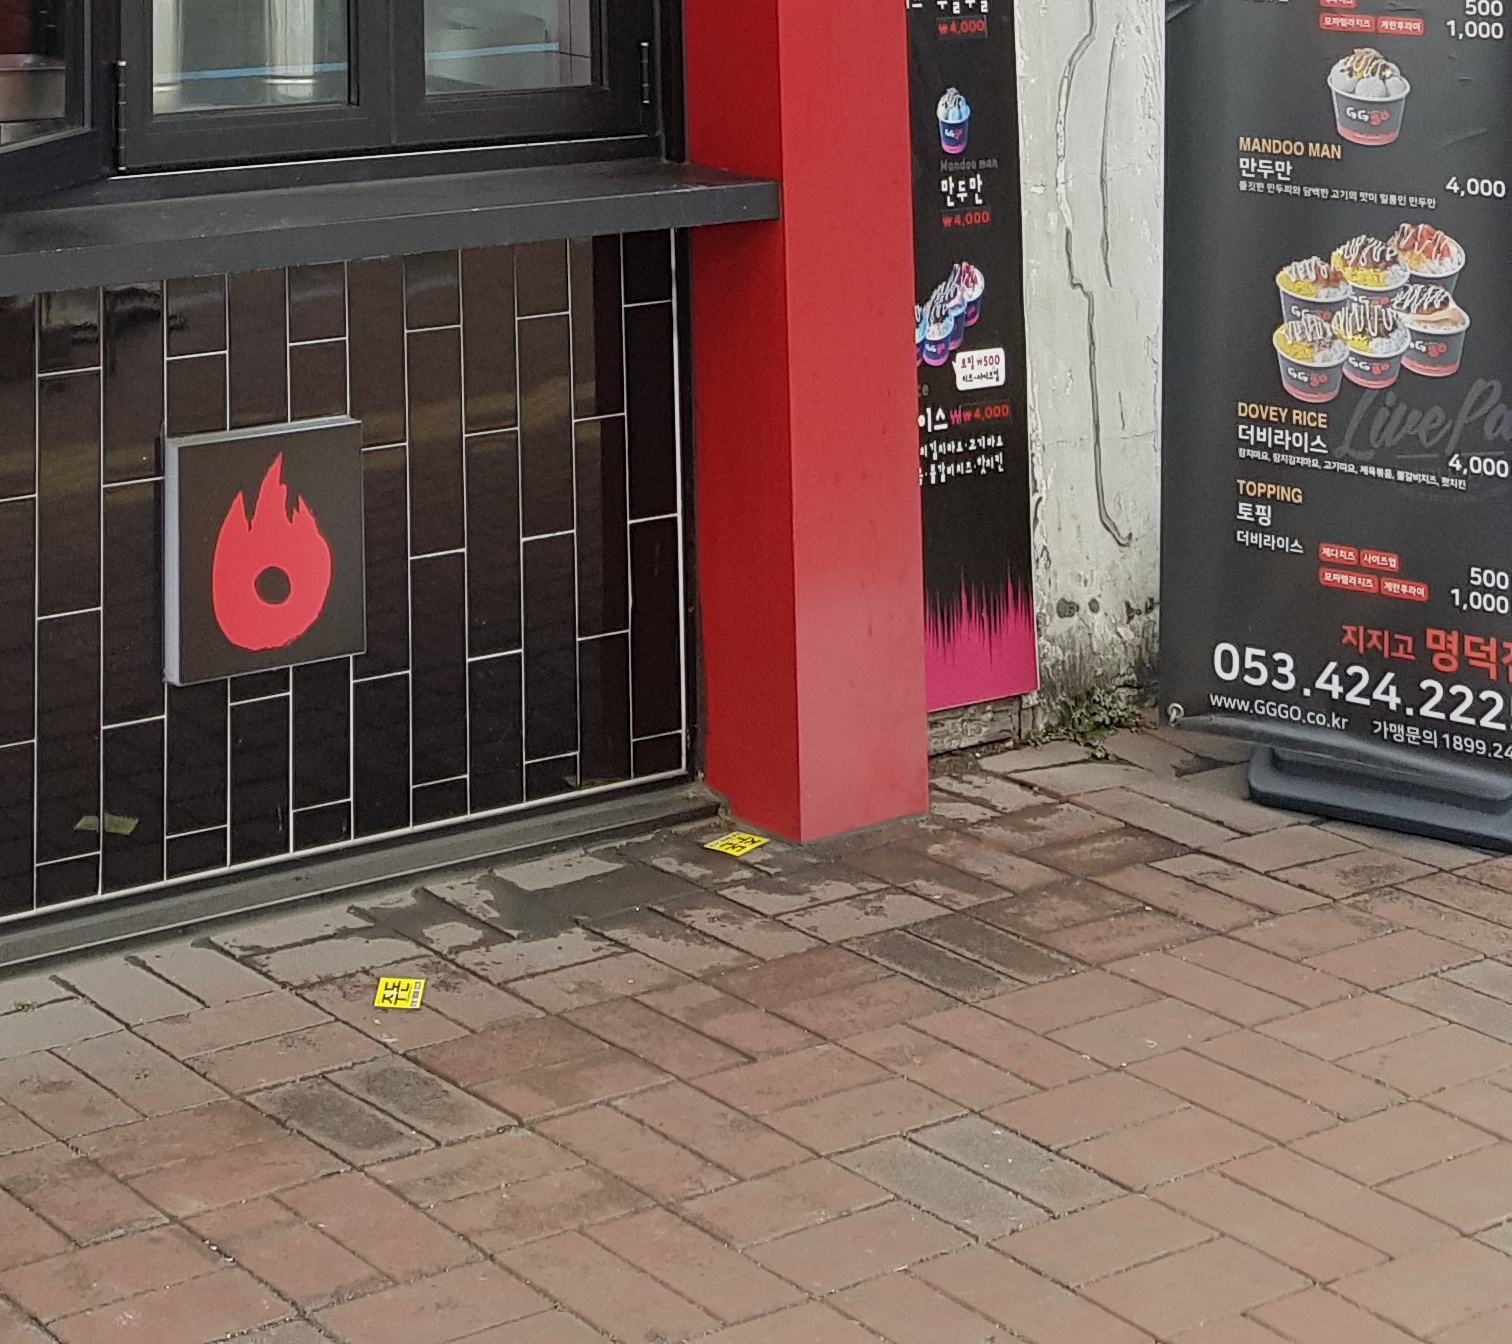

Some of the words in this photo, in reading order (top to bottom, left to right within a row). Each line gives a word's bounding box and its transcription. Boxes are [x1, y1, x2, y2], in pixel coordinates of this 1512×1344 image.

[1465, 0, 1503, 17] 500
[1446, 20, 1504, 40] 1,000
[1239, 136, 1305, 156] MANDOO
[1308, 143, 1342, 160] MAN
[941, 173, 983, 207] 만두만
[1239, 157, 1293, 181] 만두만
[1445, 177, 1506, 198] 4,000
[1238, 402, 1288, 423] DOVEY
[1292, 409, 1328, 428] RICE
[1238, 424, 1329, 454] 더비라이스
[1448, 453, 1509, 478] 4,000
[1237, 479, 1303, 503] TOPPING
[1236, 501, 1272, 527] 토핑
[1236, 530, 1304, 554] 더비라이스
[1469, 566, 1510, 590] 500
[1450, 588, 1510, 615] 1,000
[1341, 624, 1416, 661] 지지고
[1213, 642, 1512, 732] 053.424.222
[1209, 693, 1349, 730] www.GGGO.co.kr
[1372, 720, 1438, 749] 가맹문의
